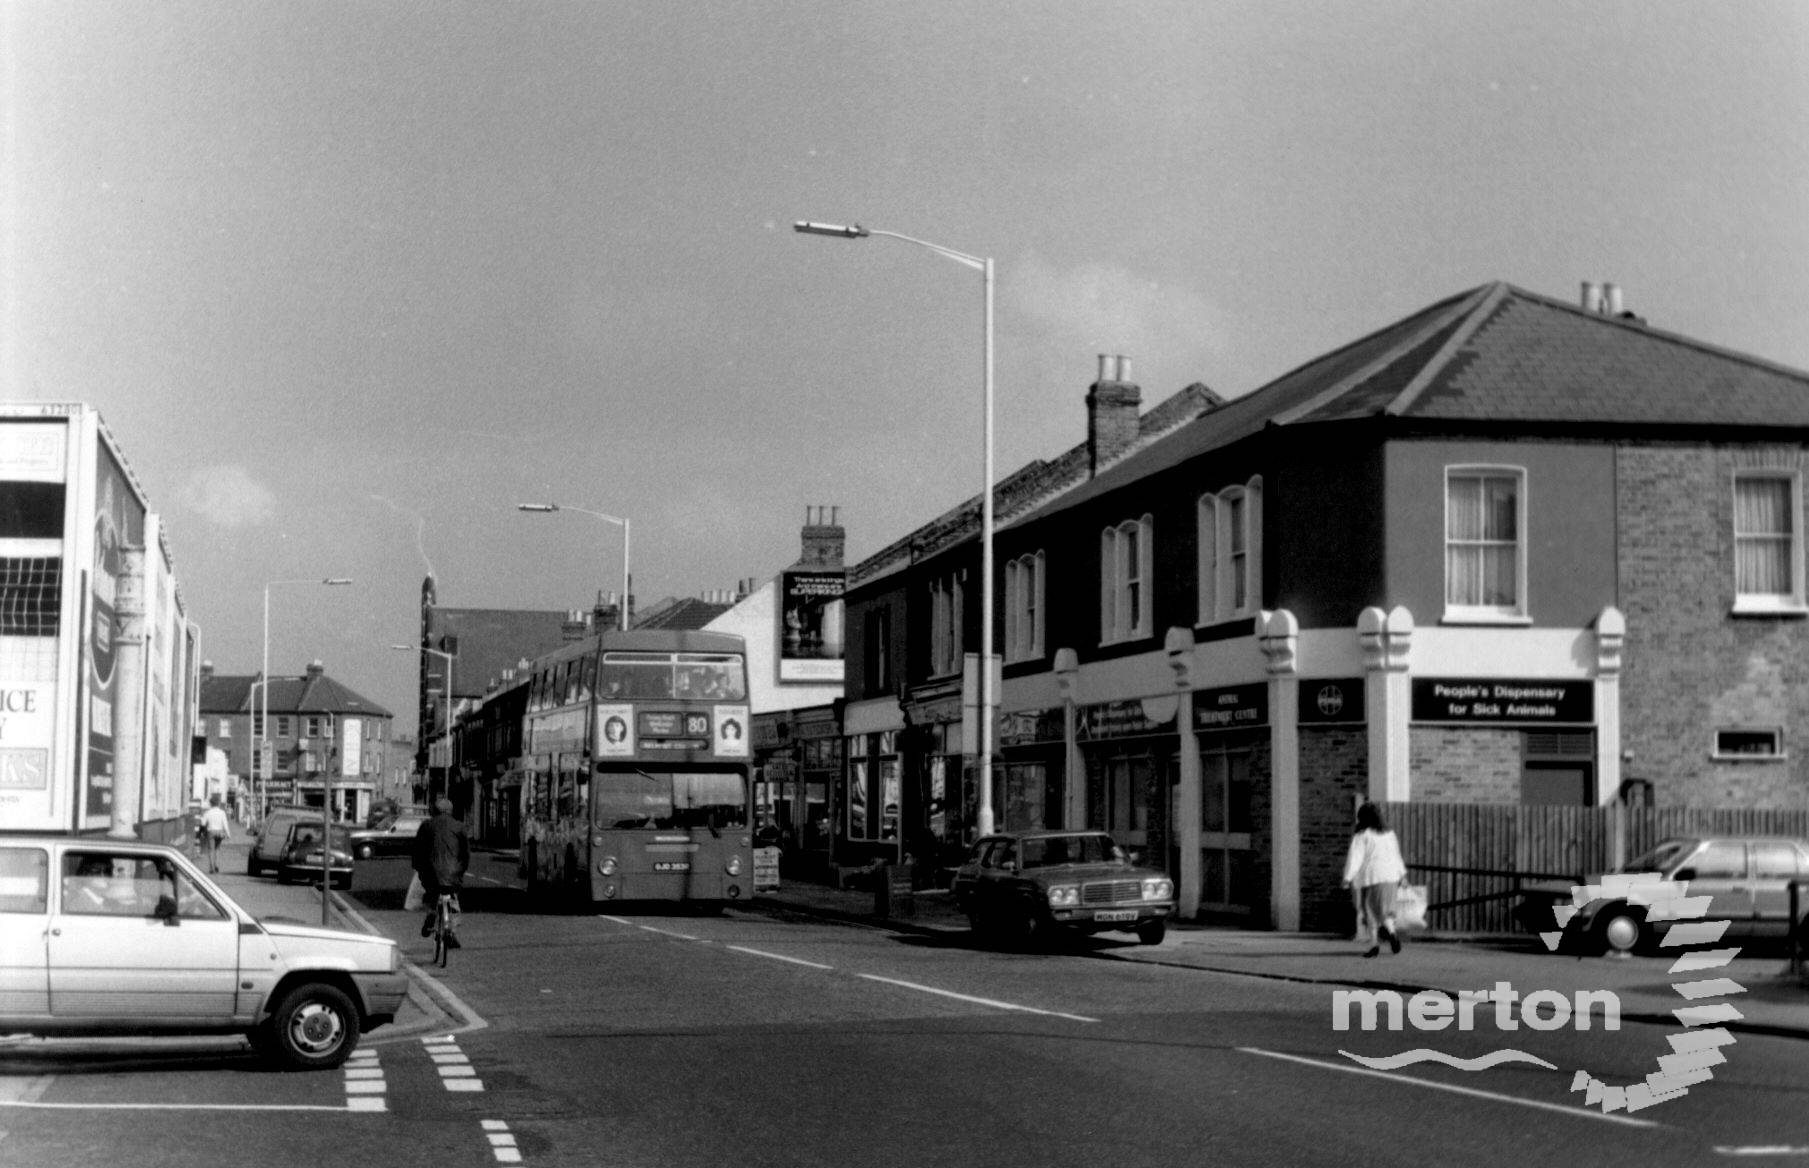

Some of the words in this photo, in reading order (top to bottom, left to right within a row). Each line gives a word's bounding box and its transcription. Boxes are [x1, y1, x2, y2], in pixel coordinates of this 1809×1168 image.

[1434, 684, 1489, 699] People's
[1494, 685, 1566, 701] Dispensary
[1448, 702, 1467, 715] for
[1473, 702, 1501, 715] Sick
[1506, 703, 1556, 716] Animals
[688, 717, 707, 732] 80
